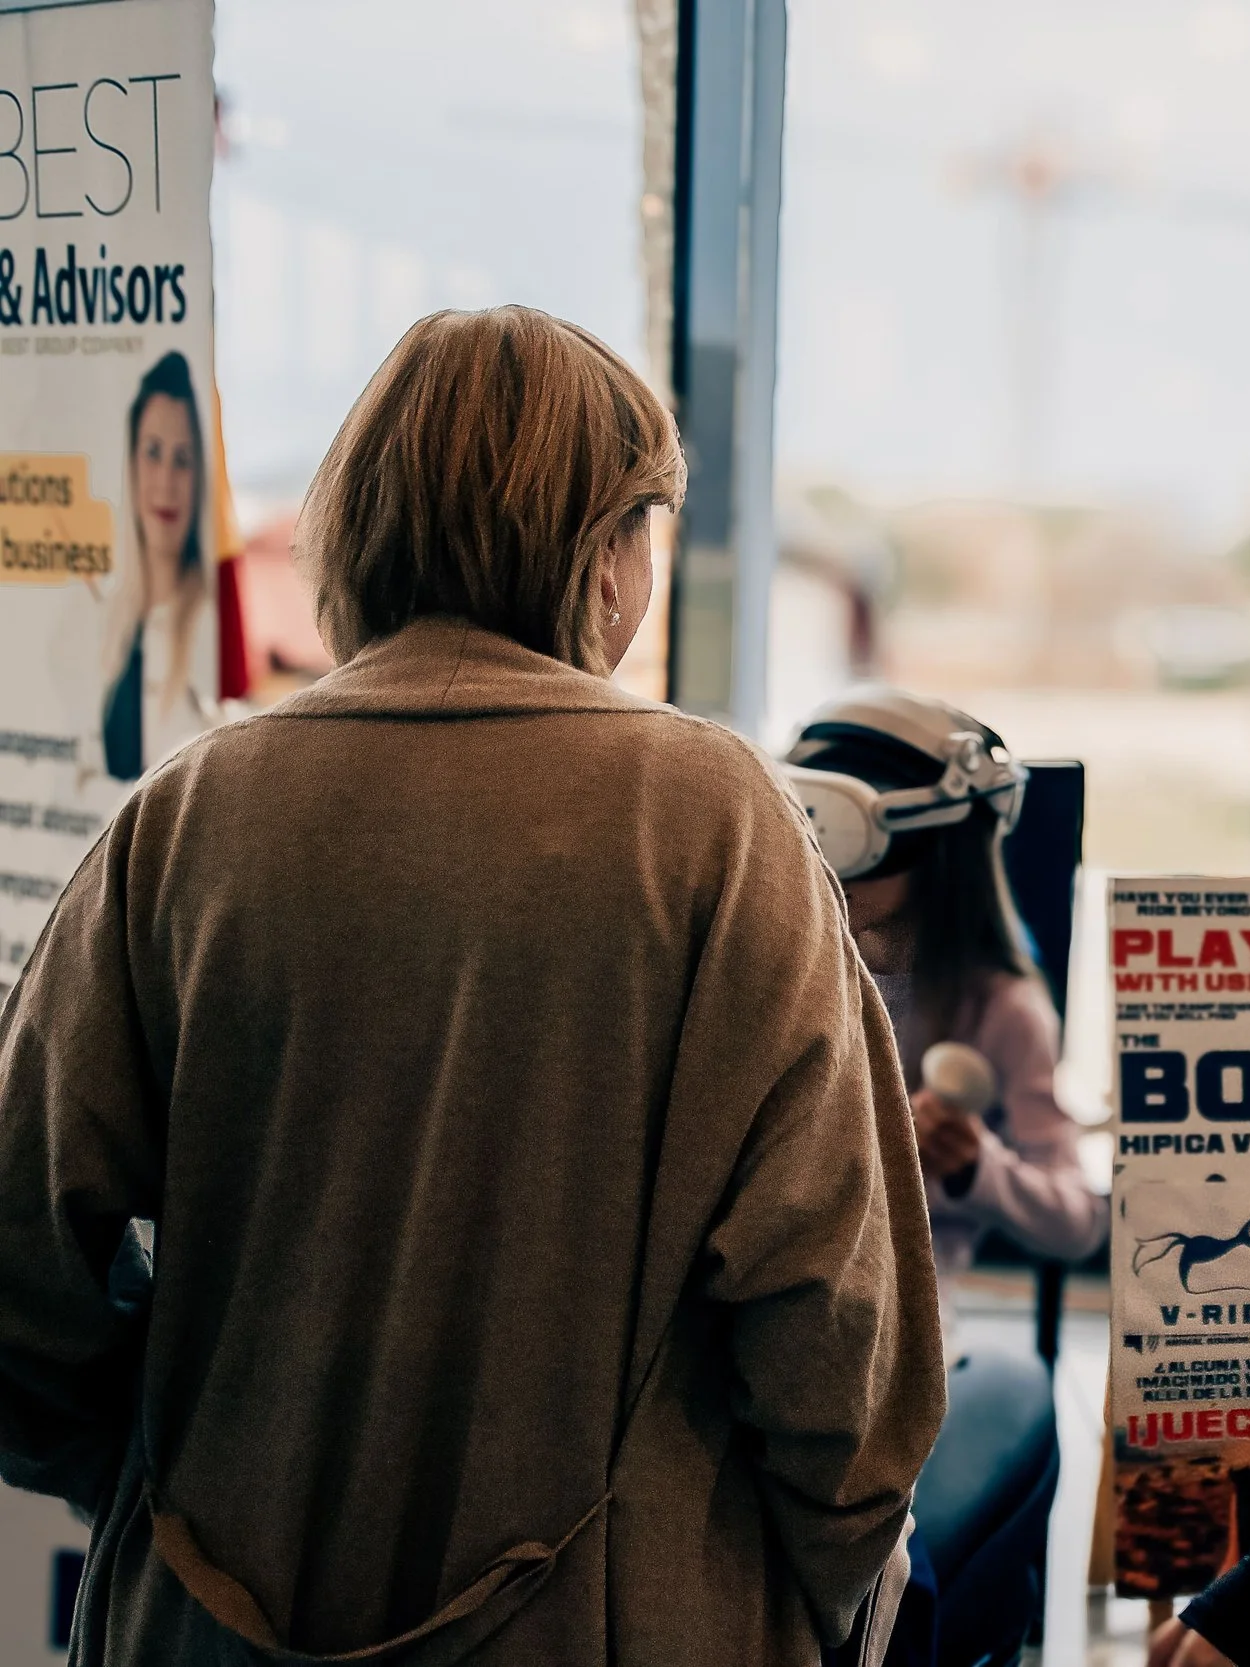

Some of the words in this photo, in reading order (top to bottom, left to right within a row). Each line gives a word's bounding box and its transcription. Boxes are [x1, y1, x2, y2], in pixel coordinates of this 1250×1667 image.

[31, 243, 186, 326] Advisors
[2, 527, 111, 574] business
[1113, 892, 1159, 904] HAVE
[1165, 892, 1200, 904] YOU
[1204, 892, 1248, 904] EVER
[1136, 905, 1177, 917] RIDE
[1181, 905, 1250, 917] BEYOND
[1114, 973, 1198, 992] WITH
[1120, 1034, 1160, 1049] THE
[1119, 1133, 1226, 1155] HIPICA
[1193, 1388, 1216, 1401] DE
[1219, 1387, 1242, 1400] LA
